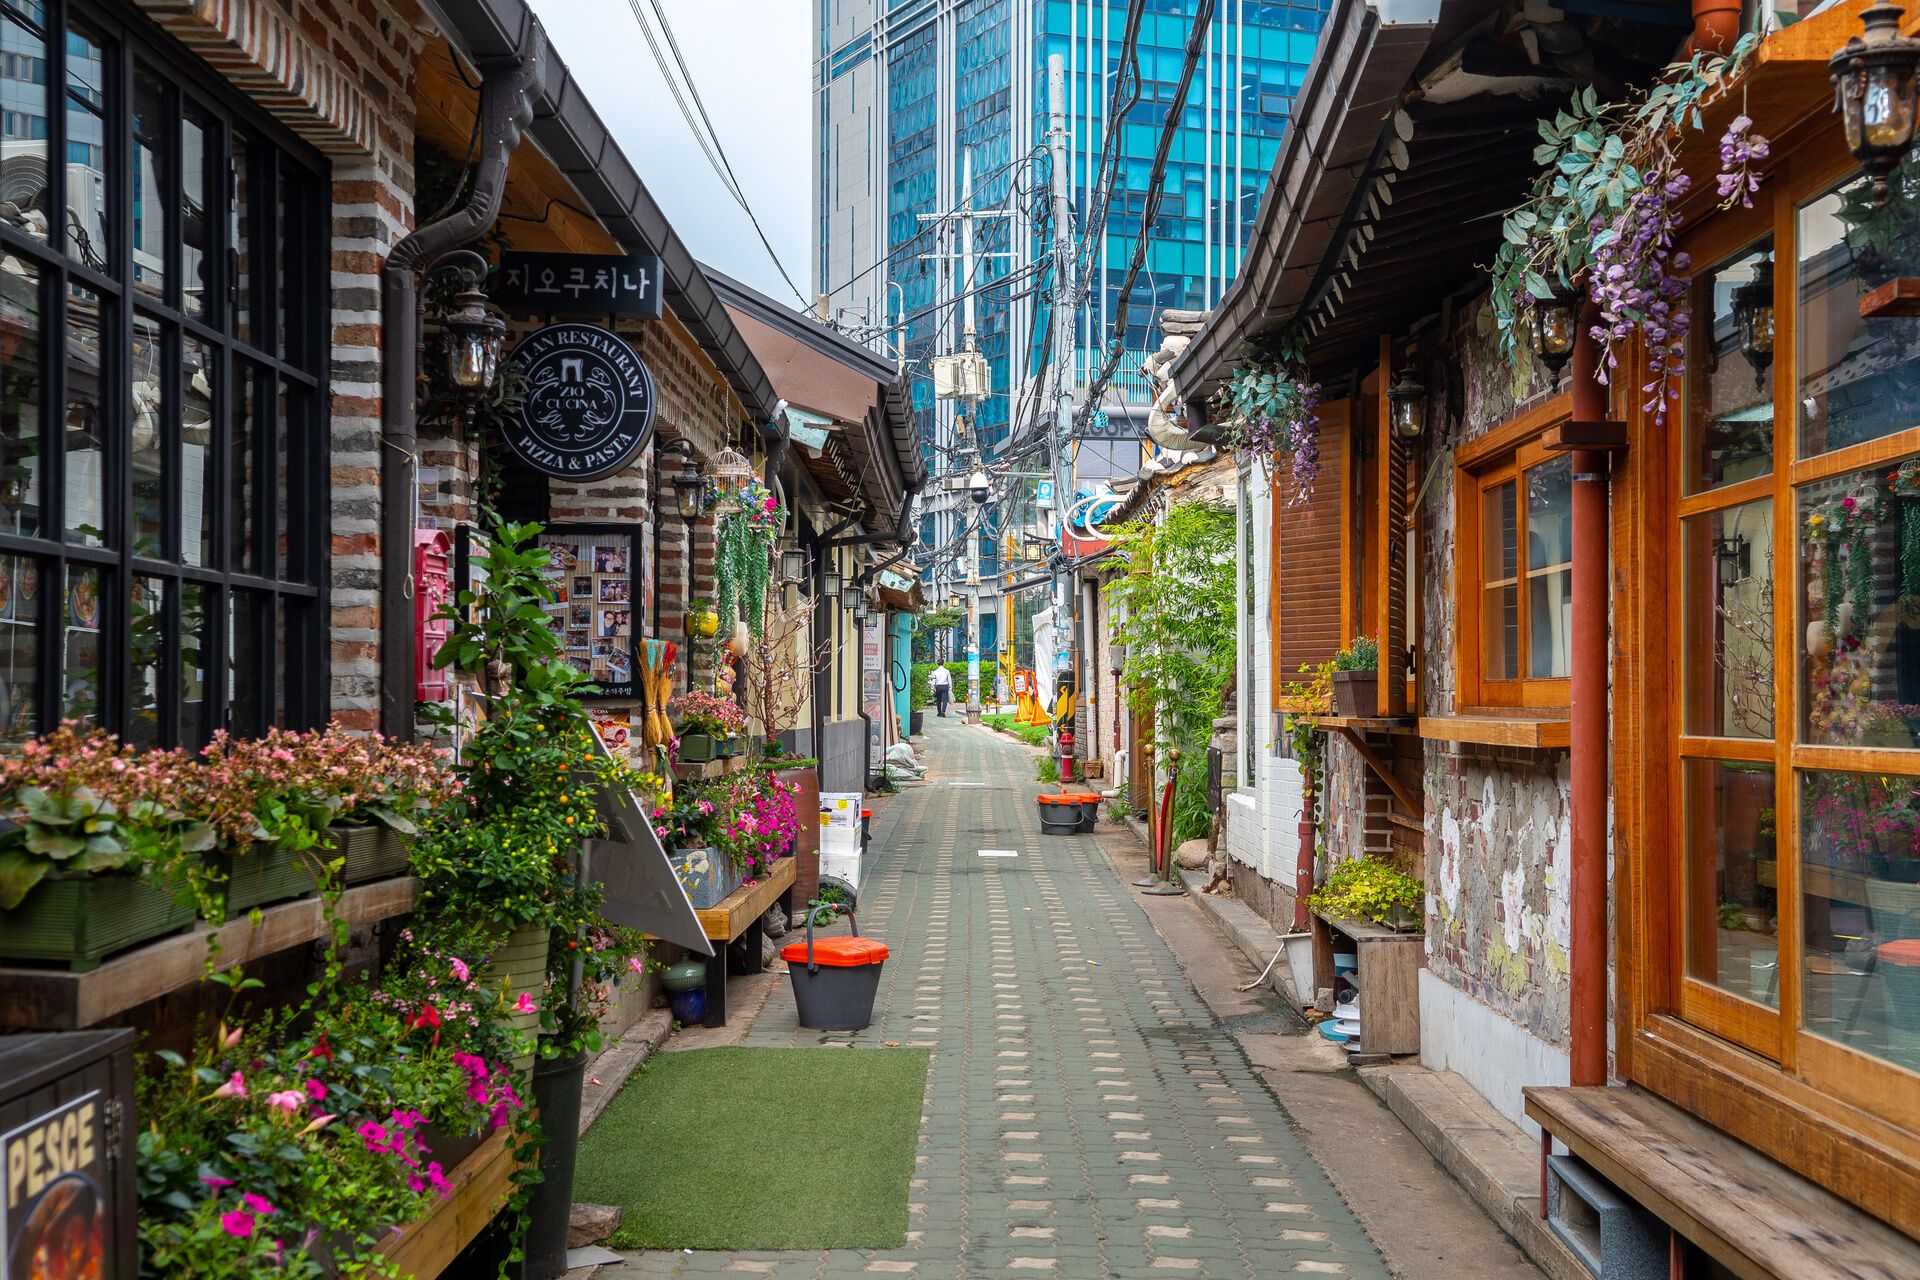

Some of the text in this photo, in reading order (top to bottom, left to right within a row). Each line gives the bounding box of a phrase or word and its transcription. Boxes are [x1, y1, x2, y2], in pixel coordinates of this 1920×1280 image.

[507, 263, 650, 300] 지오쿠치나
[558, 331, 643, 398] RESTAURANT
[546, 398, 598, 410] CUCINA
[560, 386, 585, 397] ZIO
[518, 433, 633, 470] PIZZA & PASTA
[8, 1101, 96, 1209] PESCE
